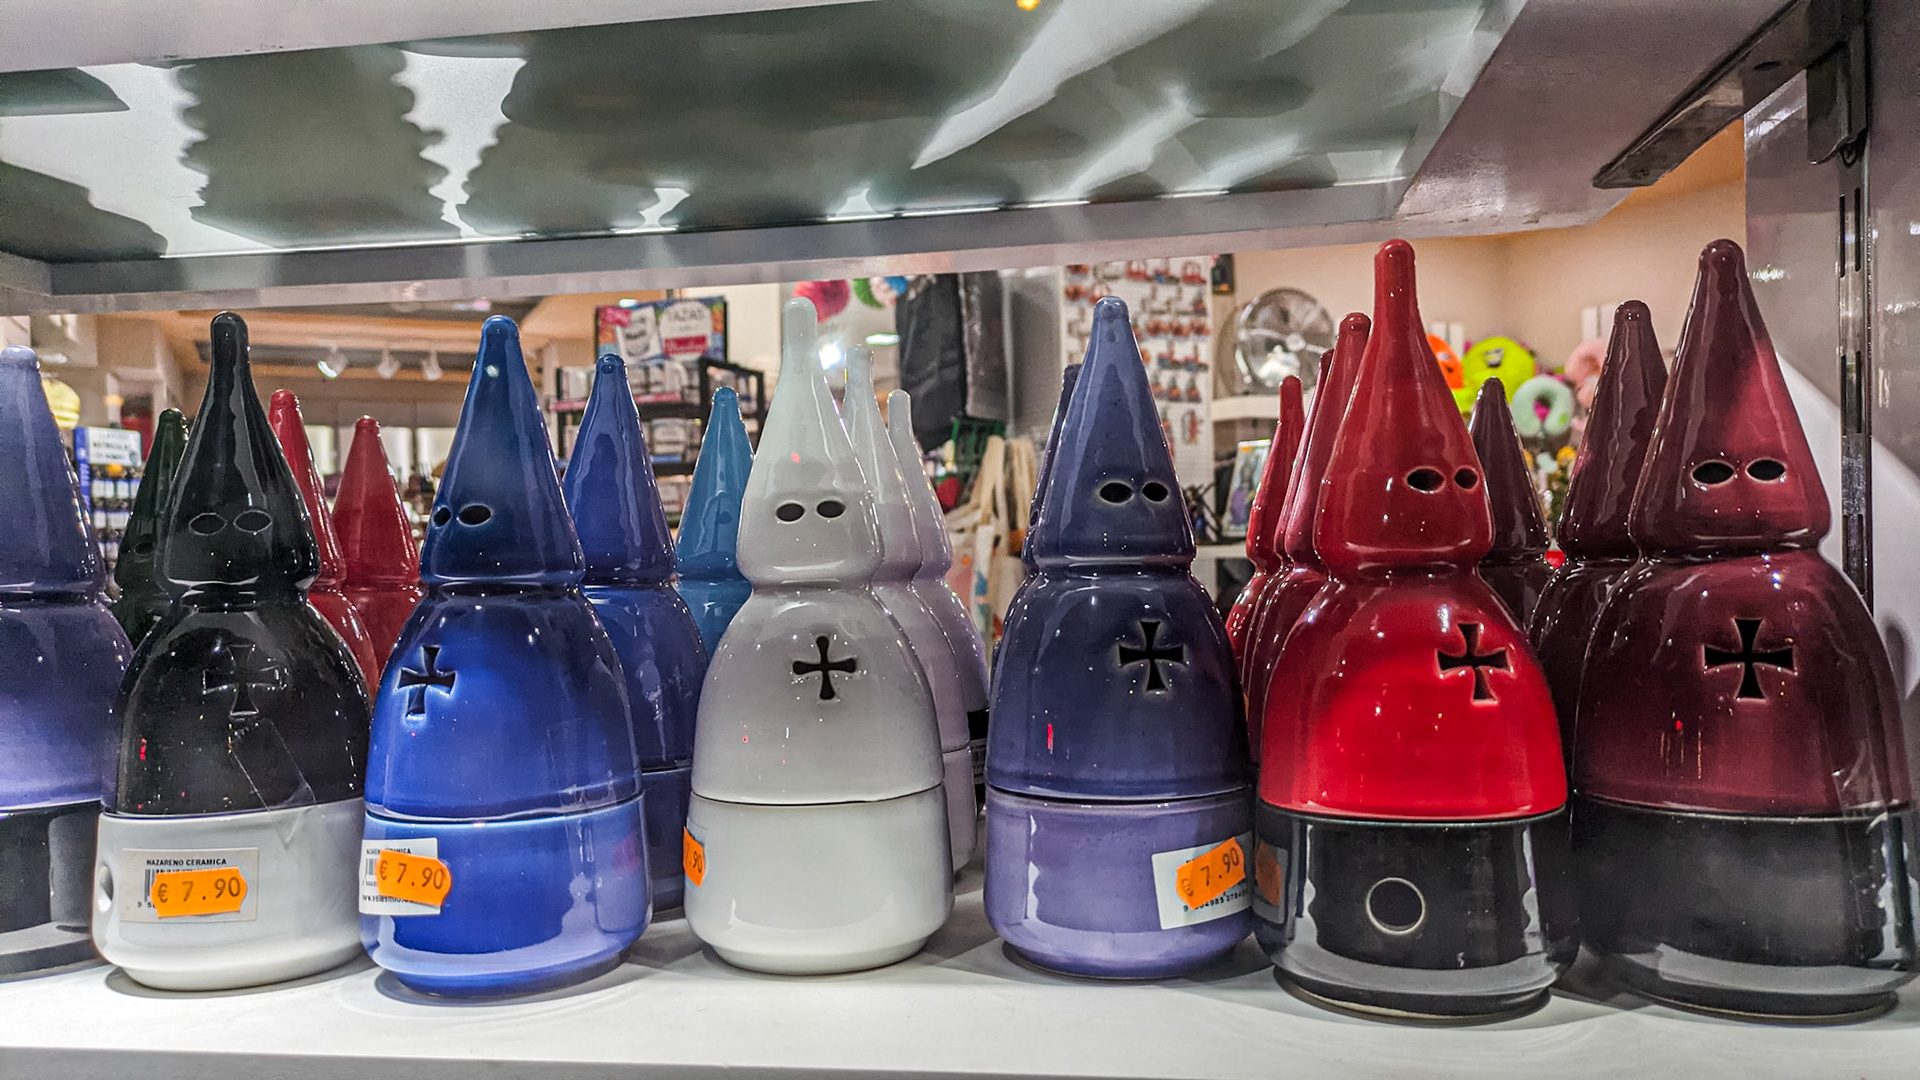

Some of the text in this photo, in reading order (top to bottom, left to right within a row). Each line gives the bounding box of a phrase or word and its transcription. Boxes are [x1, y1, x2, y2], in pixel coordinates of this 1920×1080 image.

[186, 858, 227, 866] CERAMICA
[379, 860, 445, 890] € 7.90
[1200, 847, 1240, 887] 7.90
[157, 876, 241, 903] € 7.90
